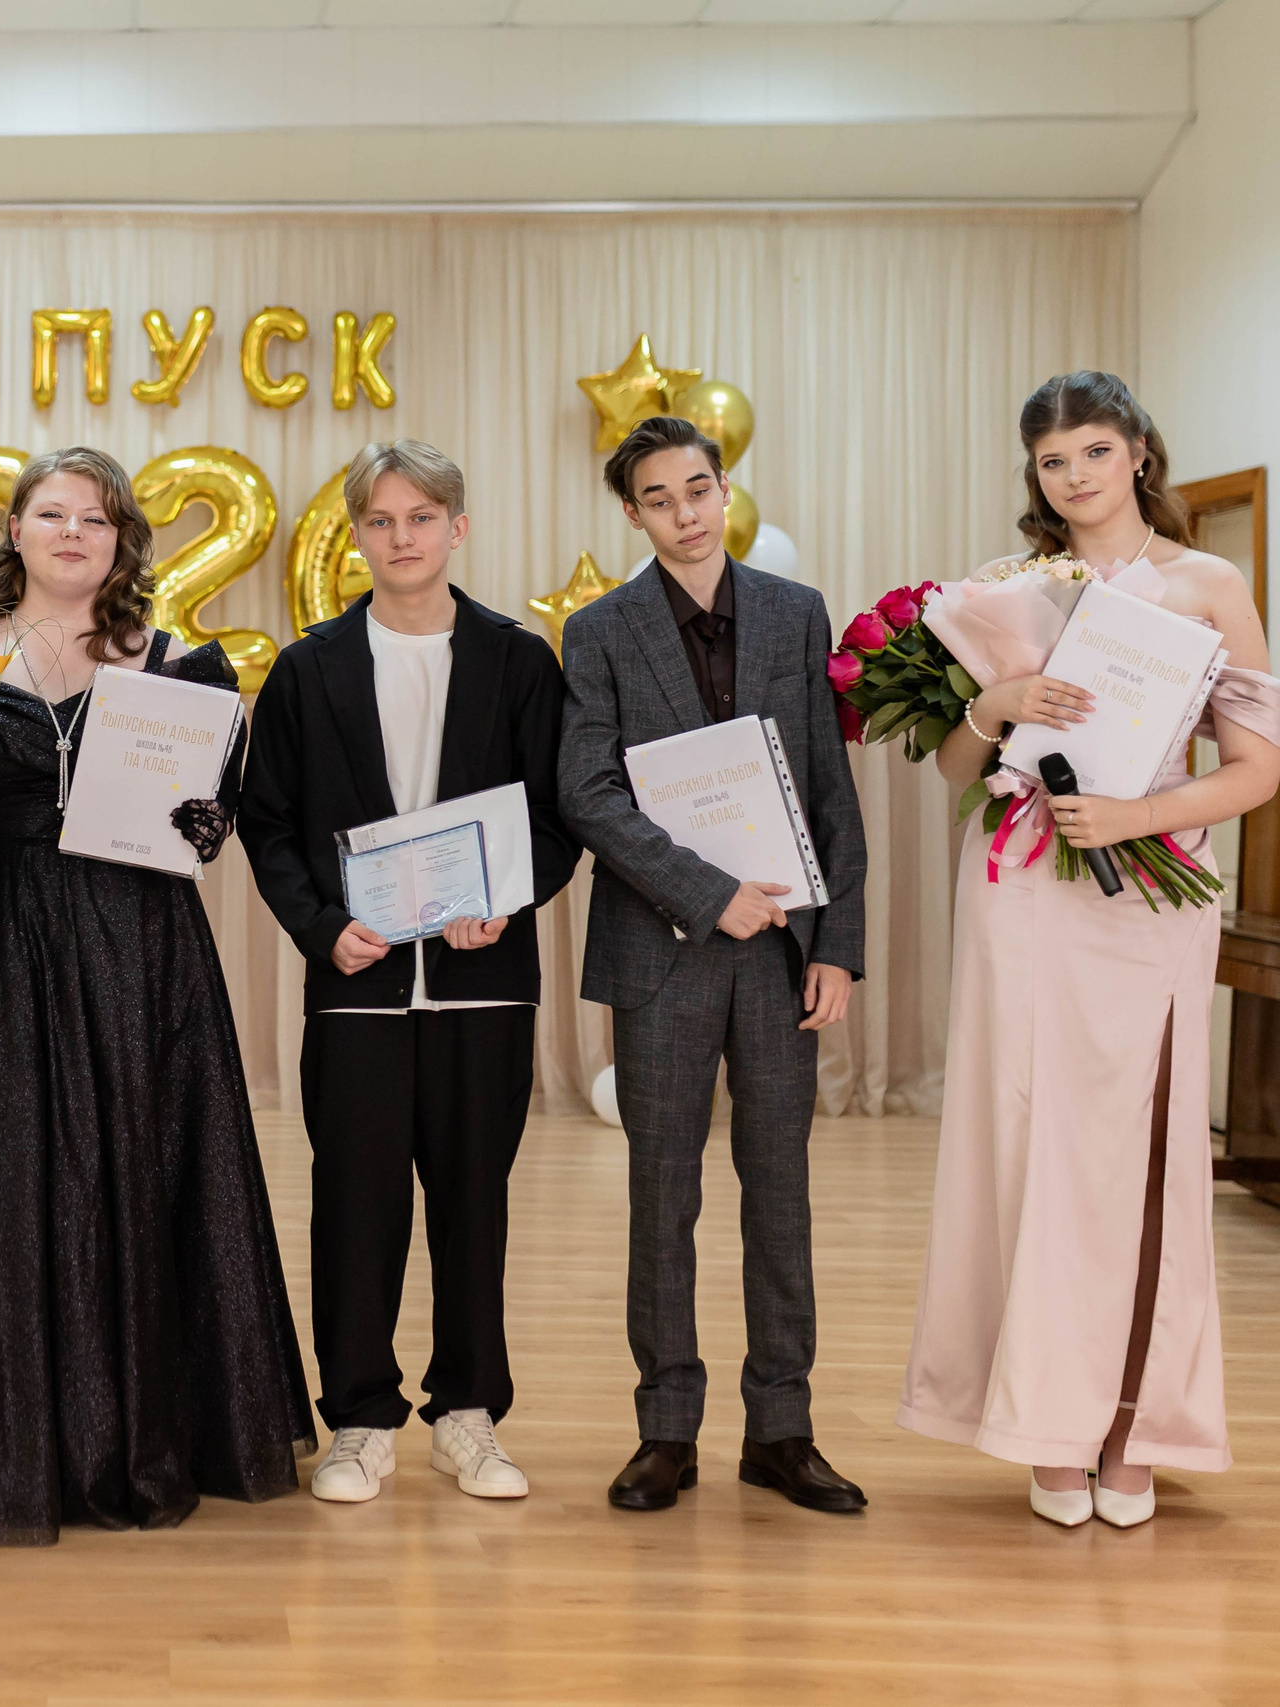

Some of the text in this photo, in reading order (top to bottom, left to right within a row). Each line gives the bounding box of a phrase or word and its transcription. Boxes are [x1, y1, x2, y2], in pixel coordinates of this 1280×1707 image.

[1078, 628, 1191, 689] ВЫПУСКНОЙ АЛЬБОМ
[1107, 664, 1129, 679] ШКОЛА
[1090, 673, 1146, 710] 11А КЛАСС
[101, 711, 215, 747] ВЫПУСКНОЙ АЛЬБОМ
[136, 739, 157, 751] ШКОЛА
[123, 751, 179, 776] 11А КЛАСС
[649, 760, 763, 804] ВЫПУСКНОЙ АЛЬБОМ
[693, 795, 713, 808] ШКОЛА
[688, 803, 745, 831] 11А КЛАСС
[111, 839, 135, 852] ВЫПУСК
